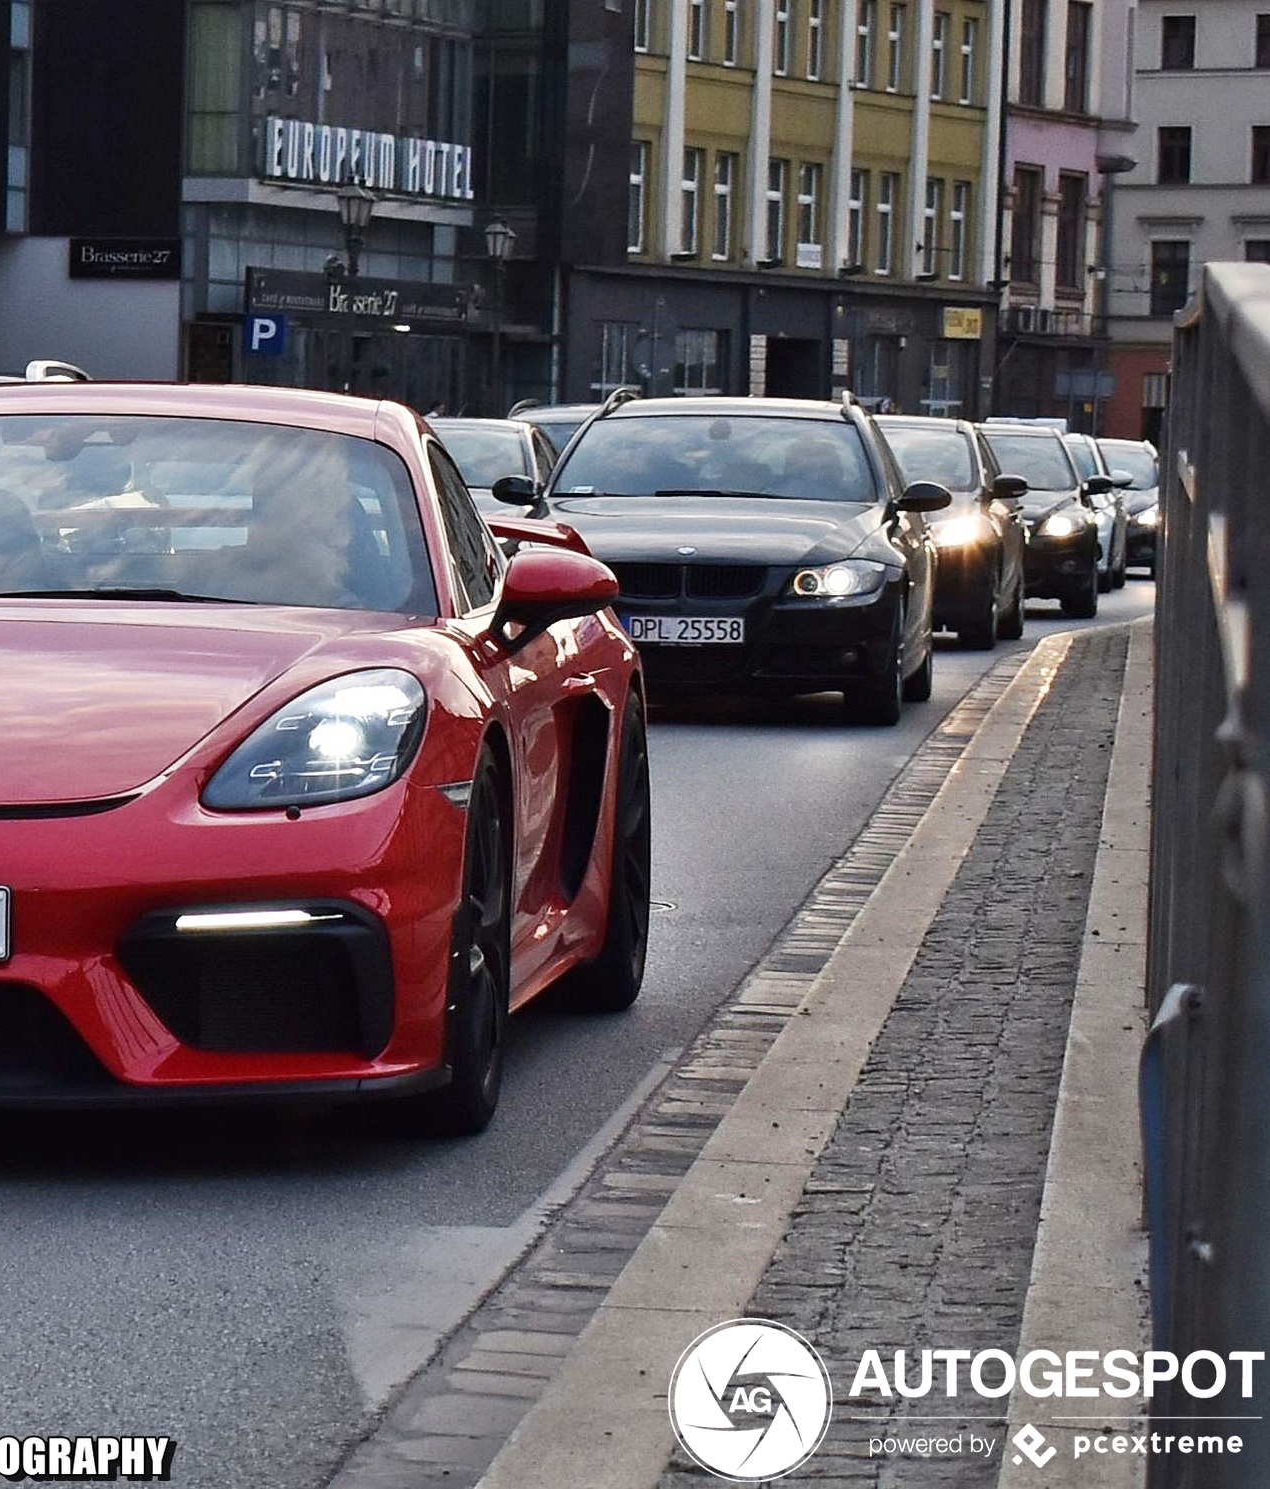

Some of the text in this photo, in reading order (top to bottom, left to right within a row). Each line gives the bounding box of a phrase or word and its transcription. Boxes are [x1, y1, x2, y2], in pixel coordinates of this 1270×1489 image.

[270, 117, 474, 199] EUROPEUM HOTEL
[251, 318, 277, 350] P
[631, 618, 741, 641] DPL 25558
